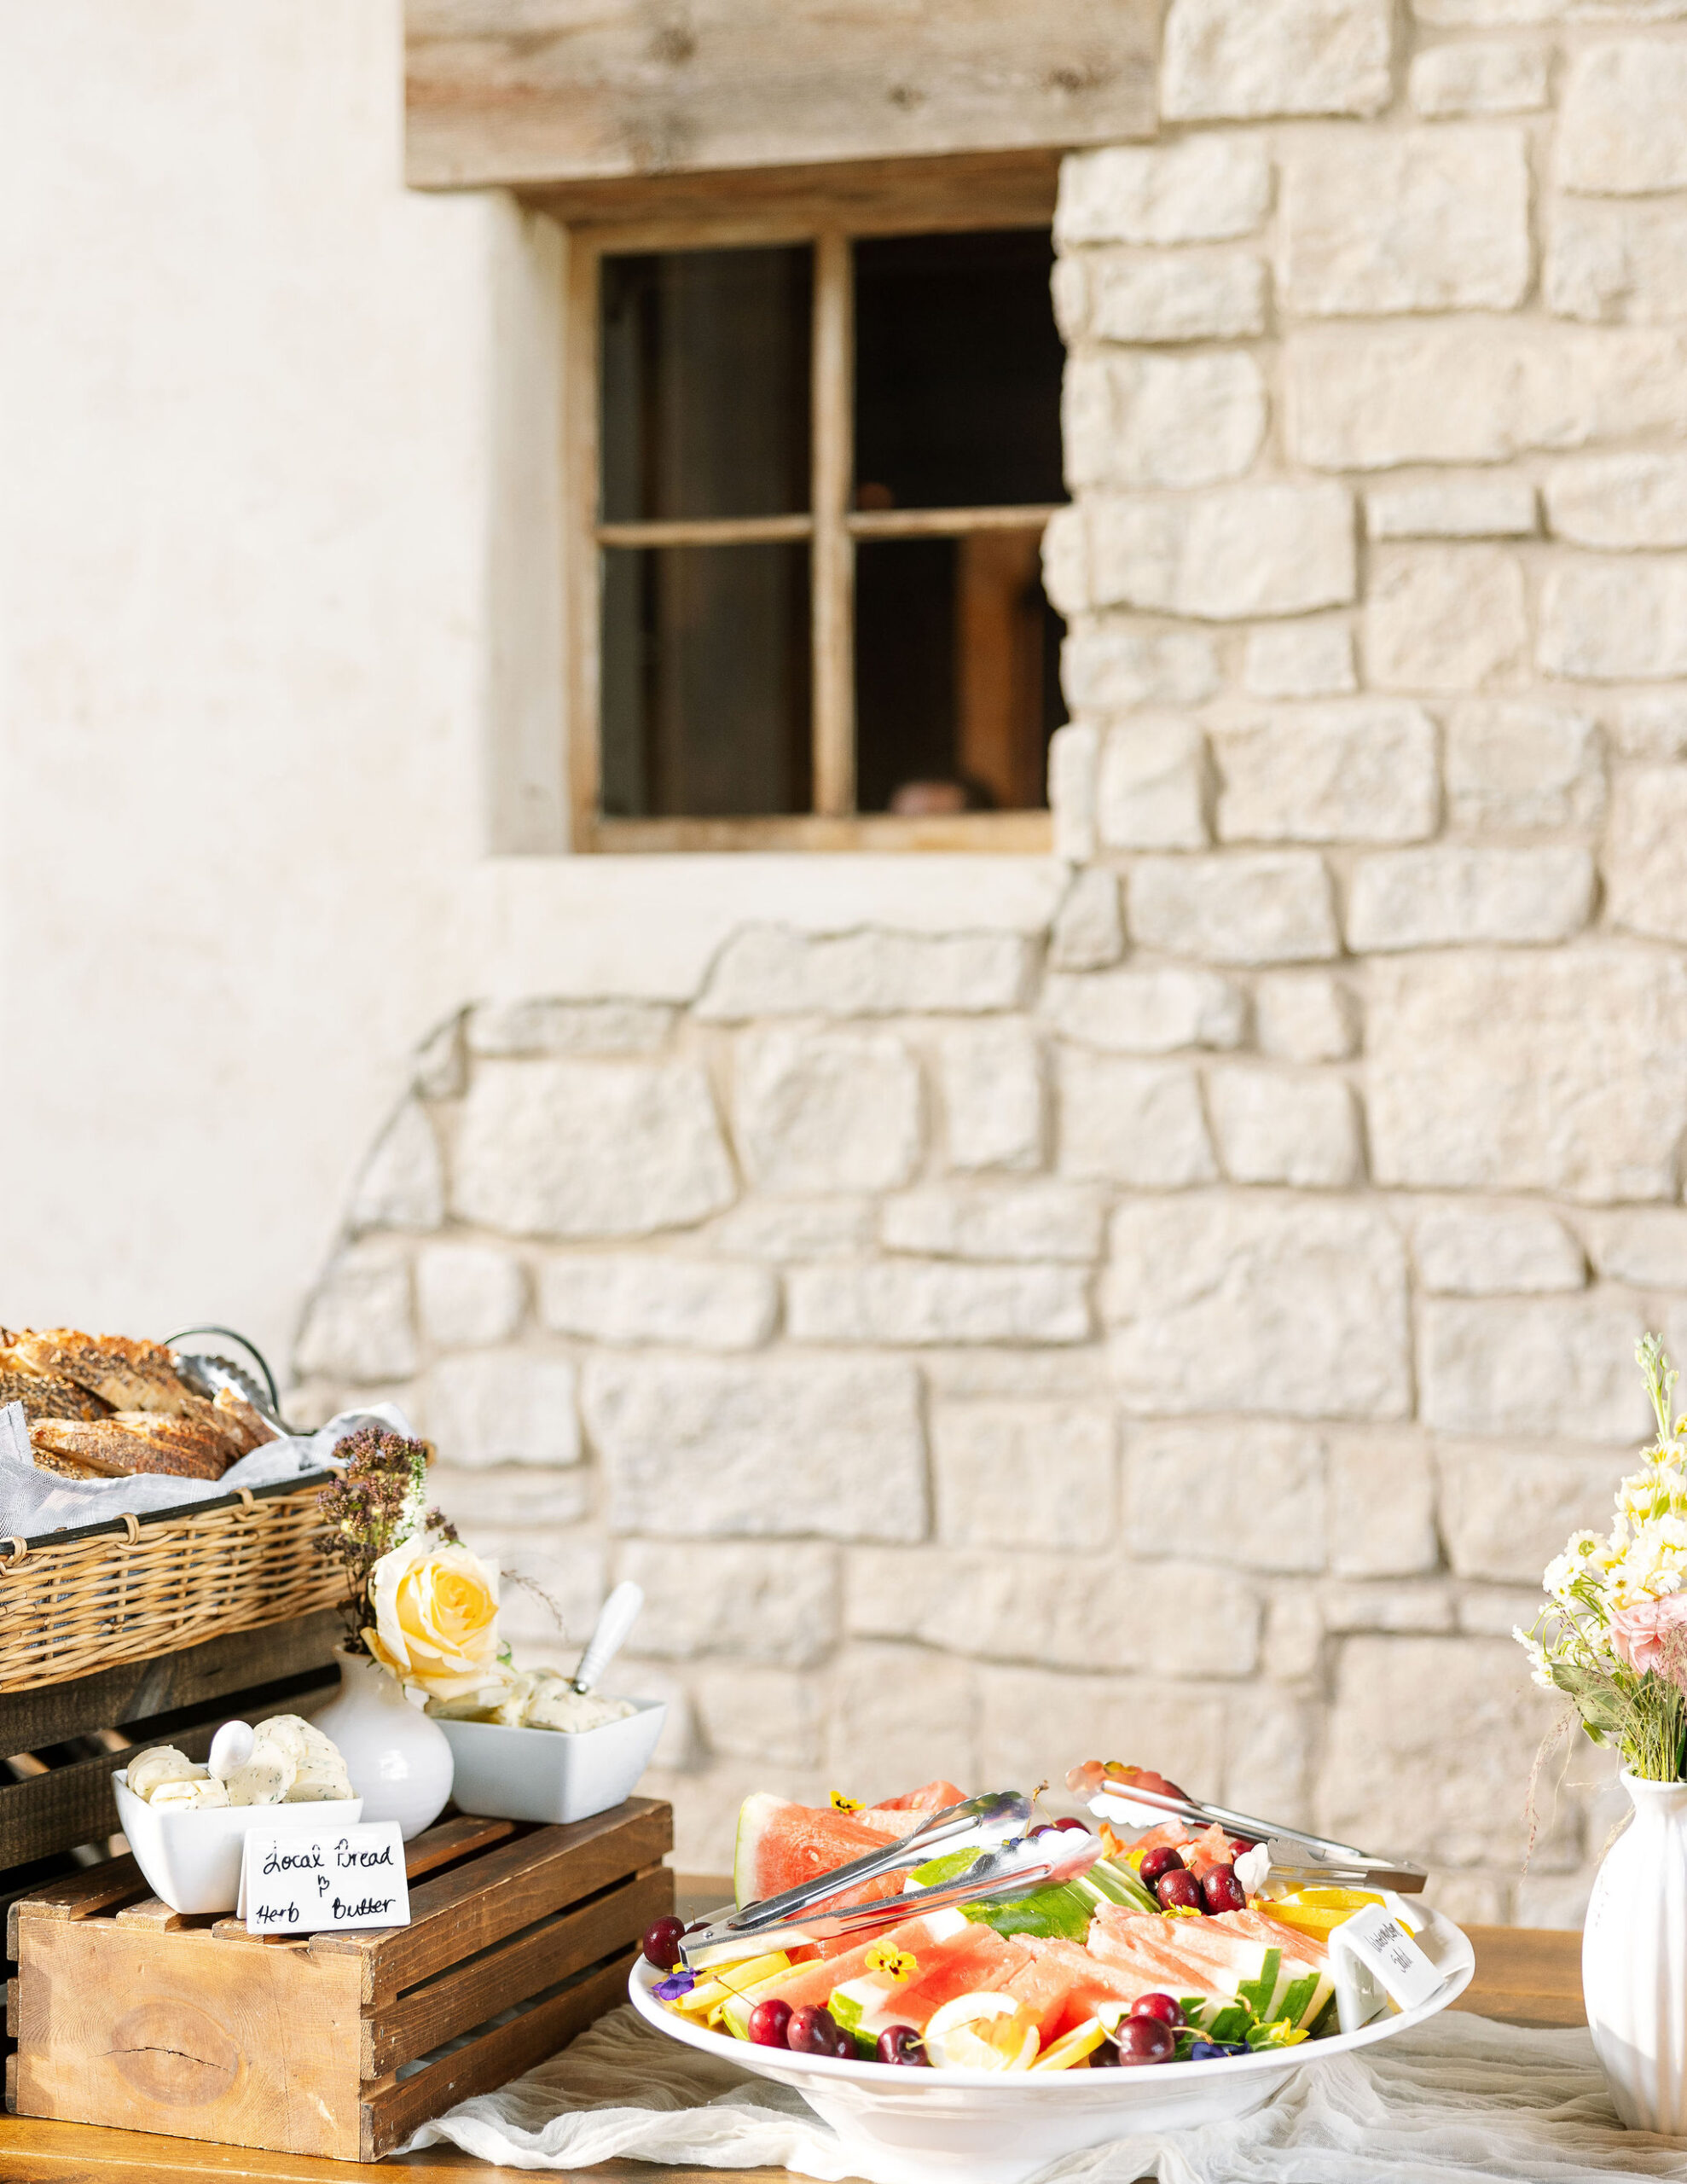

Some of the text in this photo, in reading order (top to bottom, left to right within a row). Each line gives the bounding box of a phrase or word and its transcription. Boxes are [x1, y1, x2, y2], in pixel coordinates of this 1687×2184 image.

[264, 1838, 394, 1875] Local Bread
[256, 1896, 396, 1924] Herb Butter
